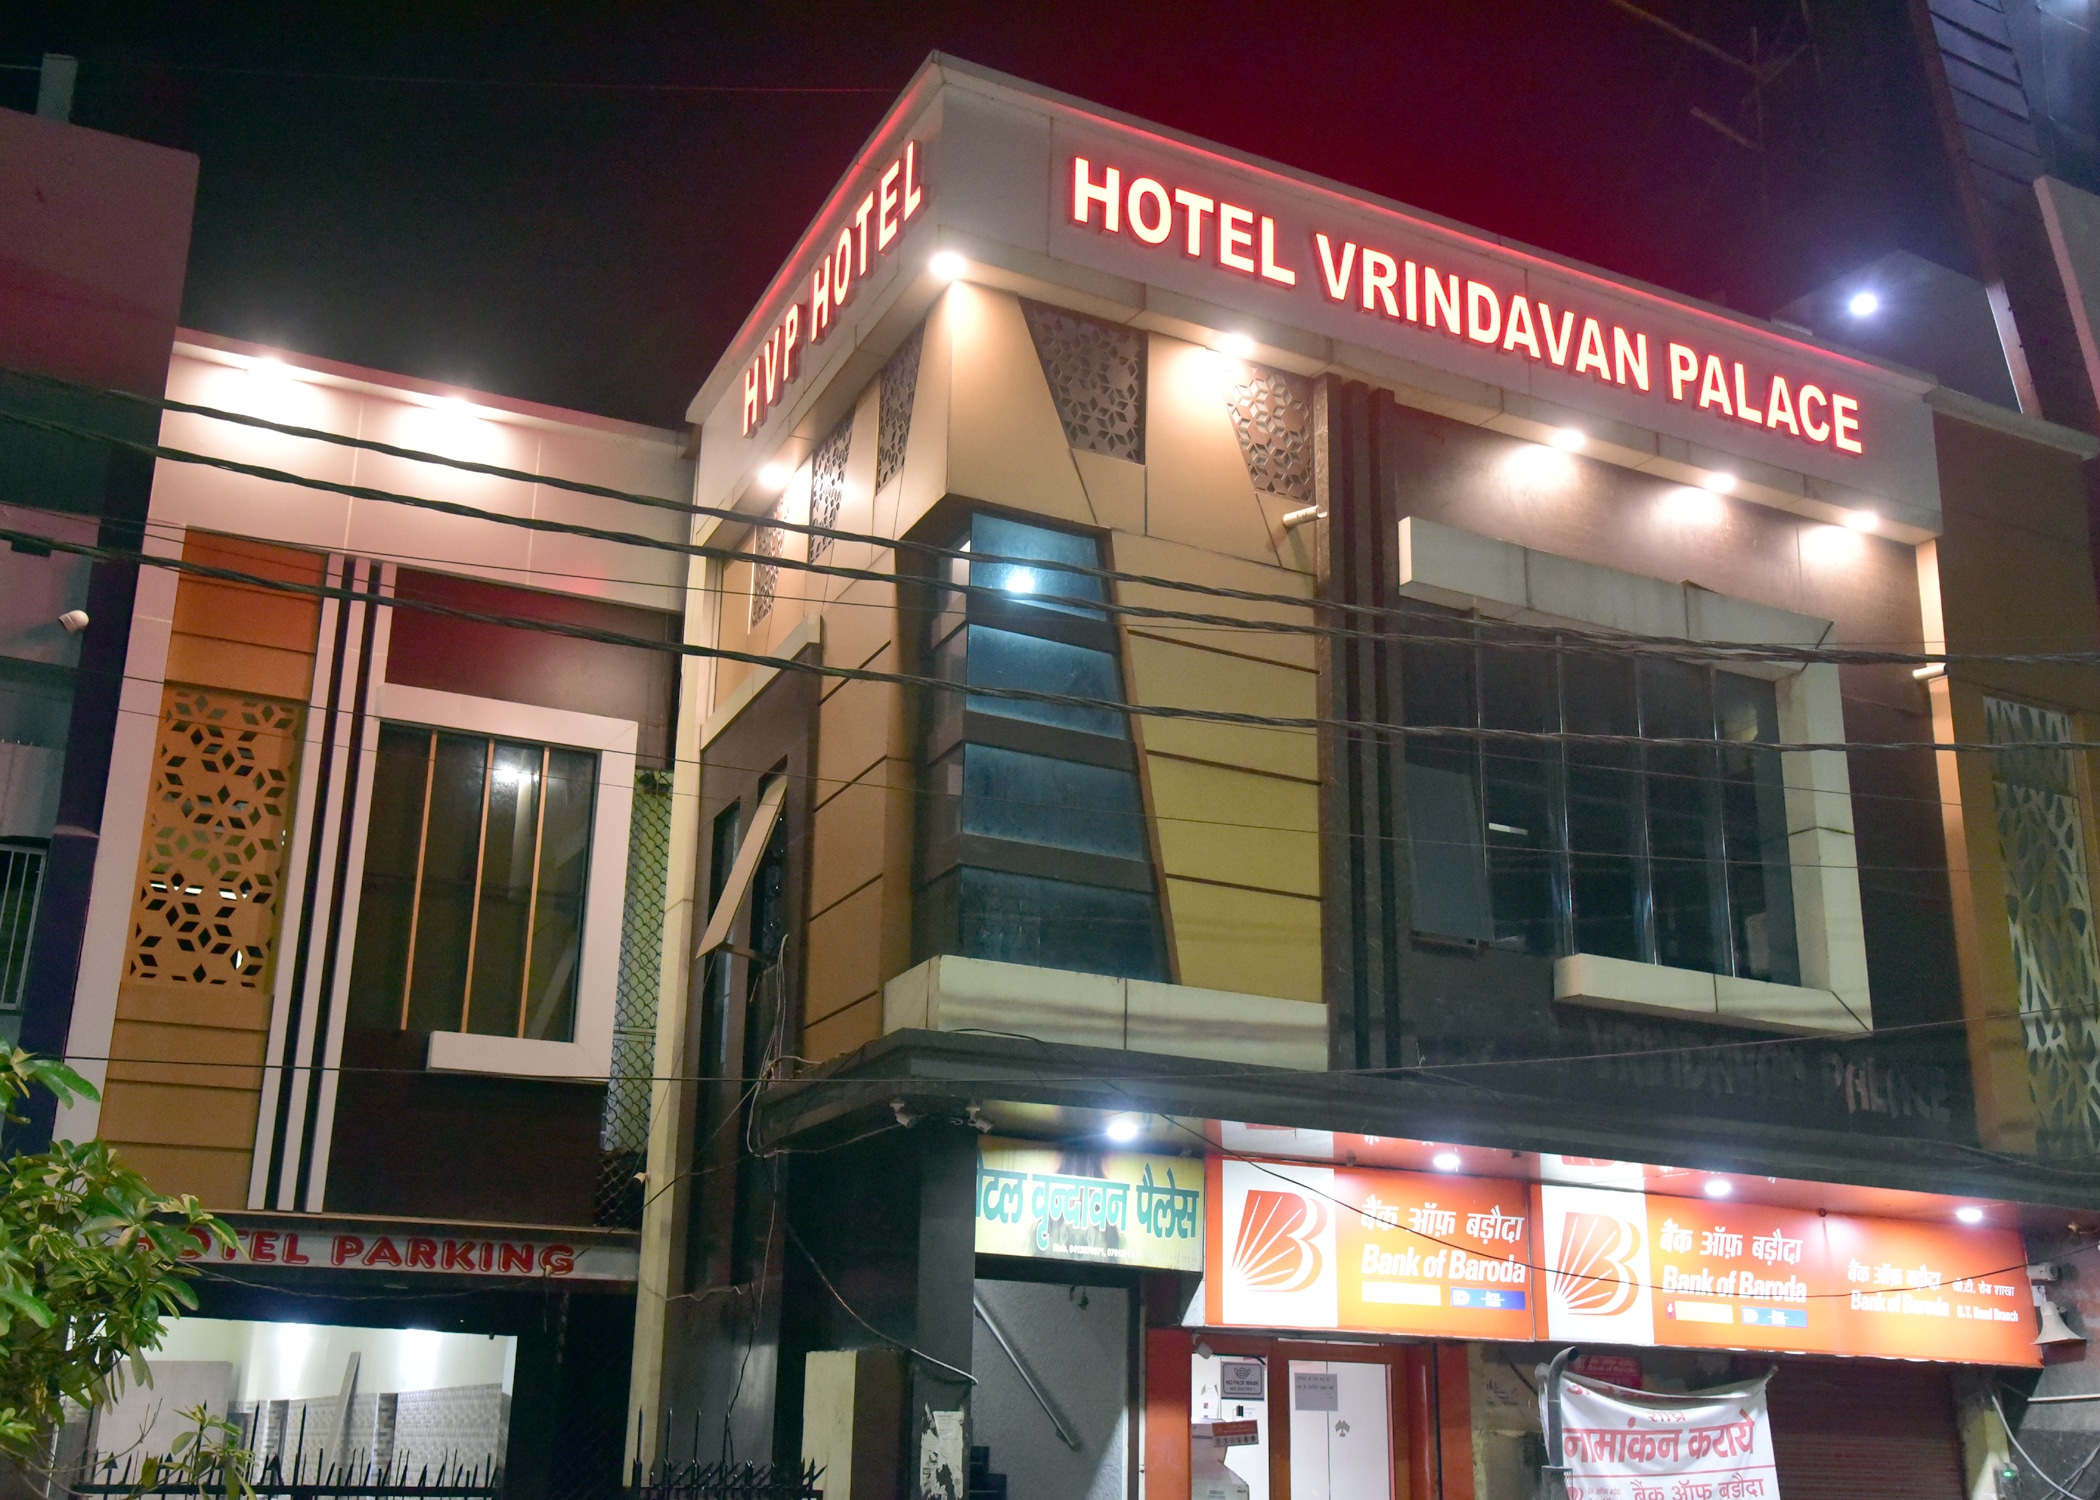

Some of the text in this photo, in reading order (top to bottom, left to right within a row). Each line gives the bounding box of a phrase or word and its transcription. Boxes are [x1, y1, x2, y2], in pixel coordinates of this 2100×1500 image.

[743, 140, 922, 437] HVP HOTEL
[1073, 156, 1863, 455] HOTEL VRINDAVAN PALACE
[975, 1148, 1199, 1250] ोटल वृन्दावन पैलेस
[1361, 1194, 1399, 1230] बैंक
[122, 1226, 575, 1275] OTEL PARKING
[1361, 1243, 1526, 1283] Bank of Baroda
[1662, 1265, 1807, 1303] Bank of Baroda
[1851, 1290, 1950, 1317] Bank of Baroda
[1993, 1285, 2015, 1297] शाखा
[1993, 1308, 2018, 1322] Branch
[1562, 1416, 1683, 1463] नामांकन
